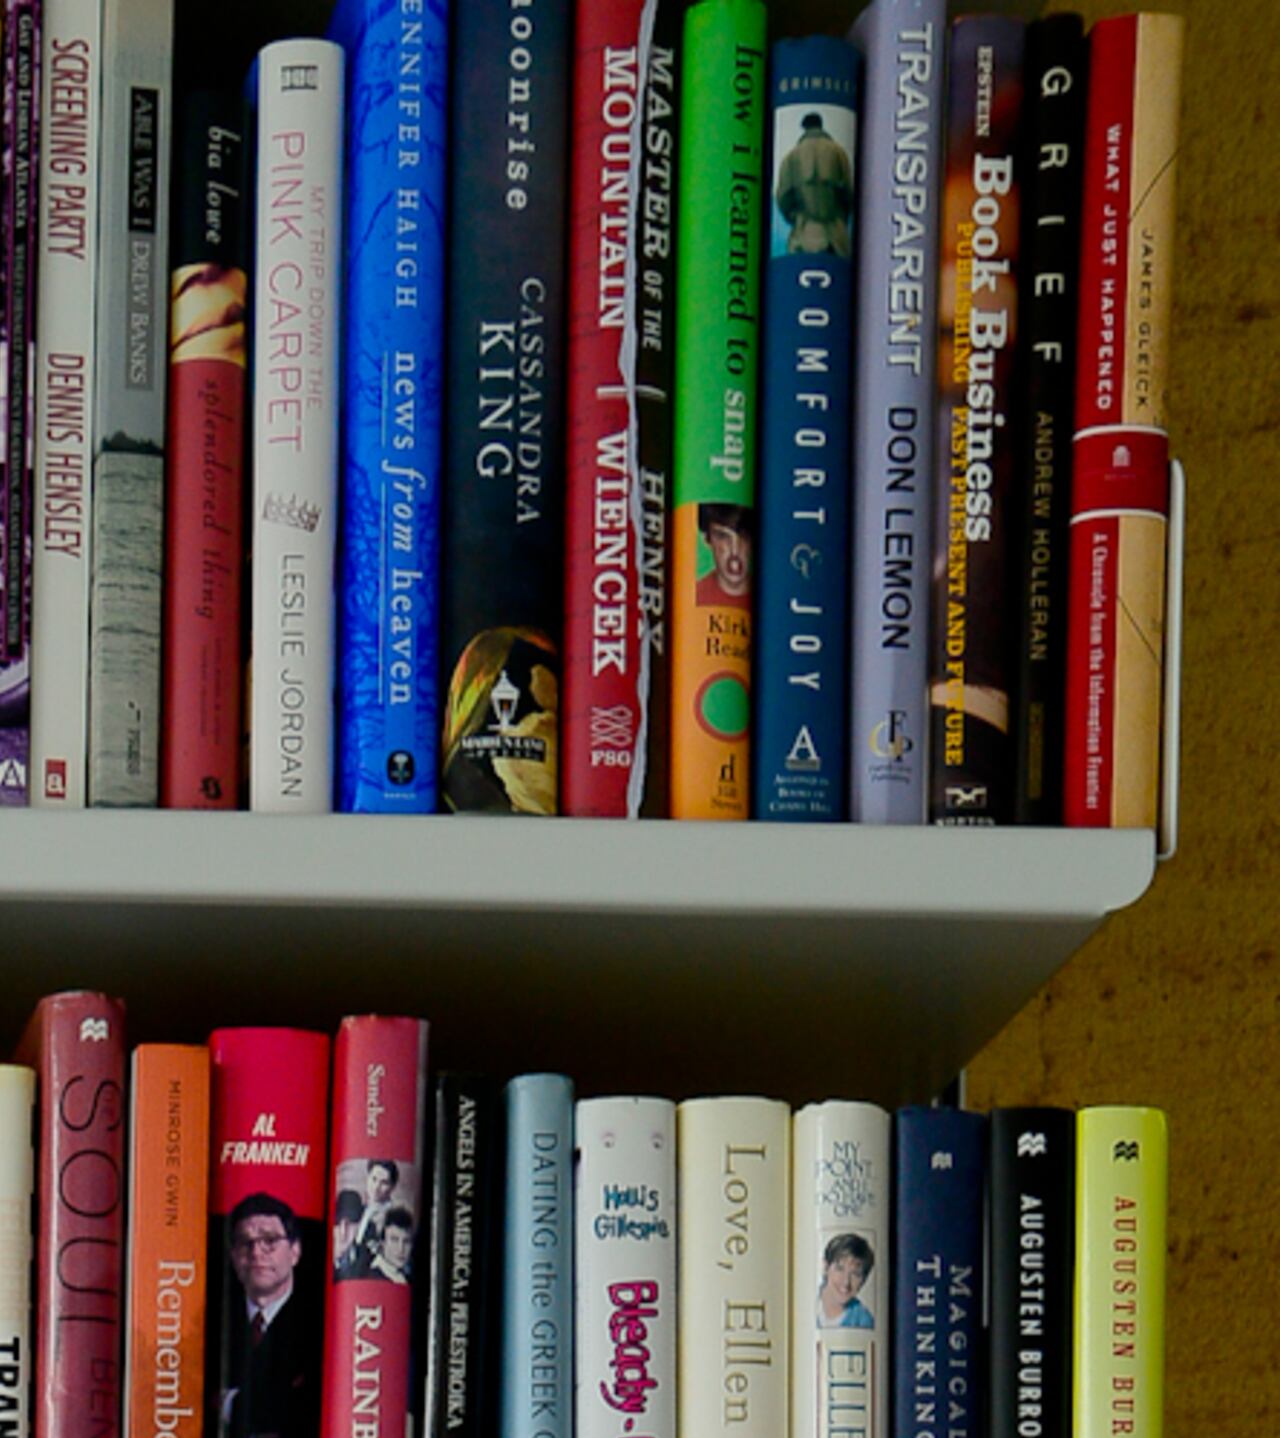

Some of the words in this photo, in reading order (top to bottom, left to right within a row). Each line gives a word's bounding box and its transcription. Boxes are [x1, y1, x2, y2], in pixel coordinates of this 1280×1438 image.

[971, 153, 1013, 291] Book
[884, 406, 917, 492] DON
[963, 303, 1009, 542] Business
[279, 555, 306, 658] LESLIE
[881, 507, 915, 650] LEMON
[279, 670, 306, 797] JORDAN
[221, 1141, 309, 1166] FRANKEN
[252, 1113, 276, 1138] AL
[367, 1065, 385, 1138] Sanchez
[1020, 1196, 1045, 1335] AUGUSTEN
